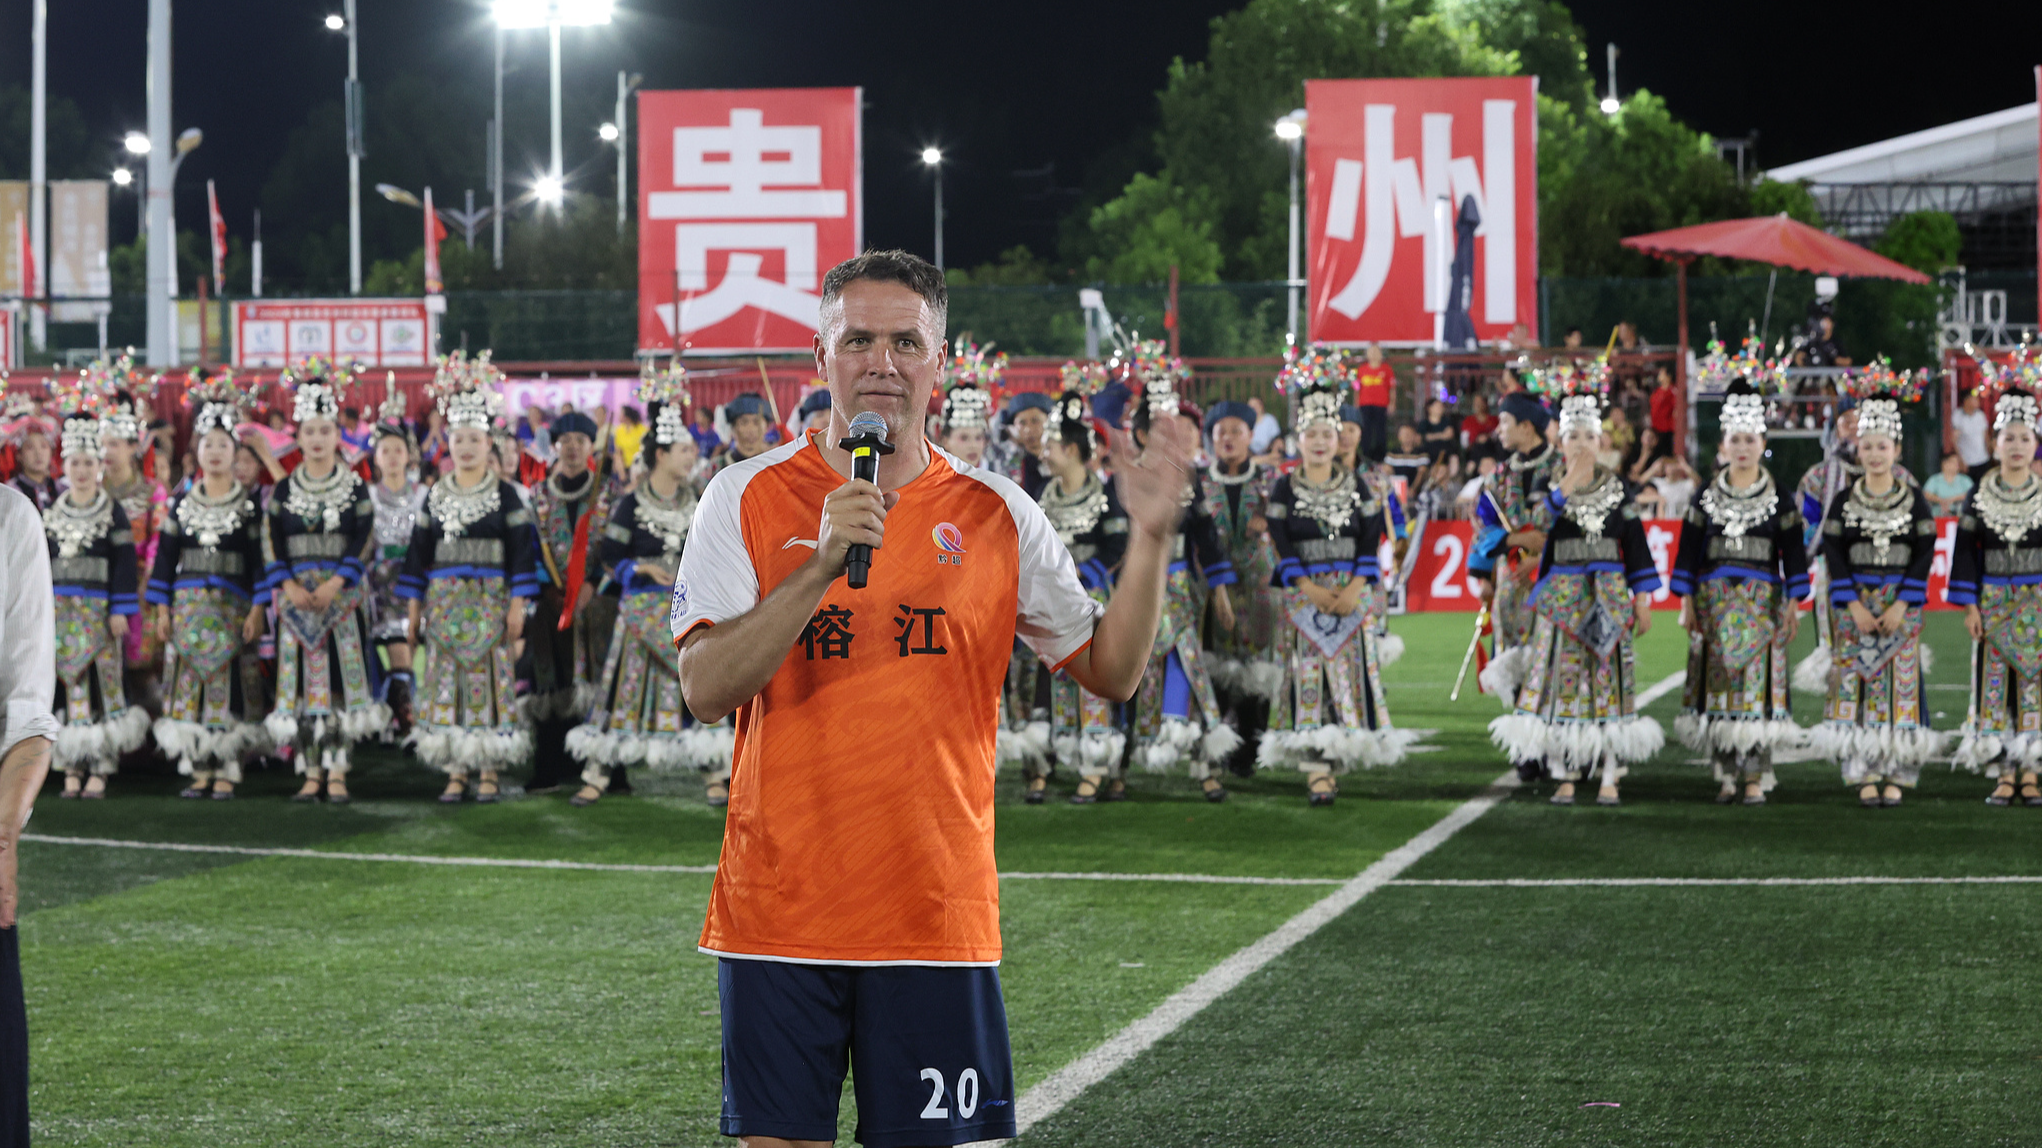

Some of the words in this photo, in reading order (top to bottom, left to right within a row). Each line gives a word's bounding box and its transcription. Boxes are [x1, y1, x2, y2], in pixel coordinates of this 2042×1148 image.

[648, 108, 847, 337] 贵
[1327, 99, 1517, 324] 州
[798, 603, 949, 661] 榕江
[919, 1066, 980, 1120] 20
